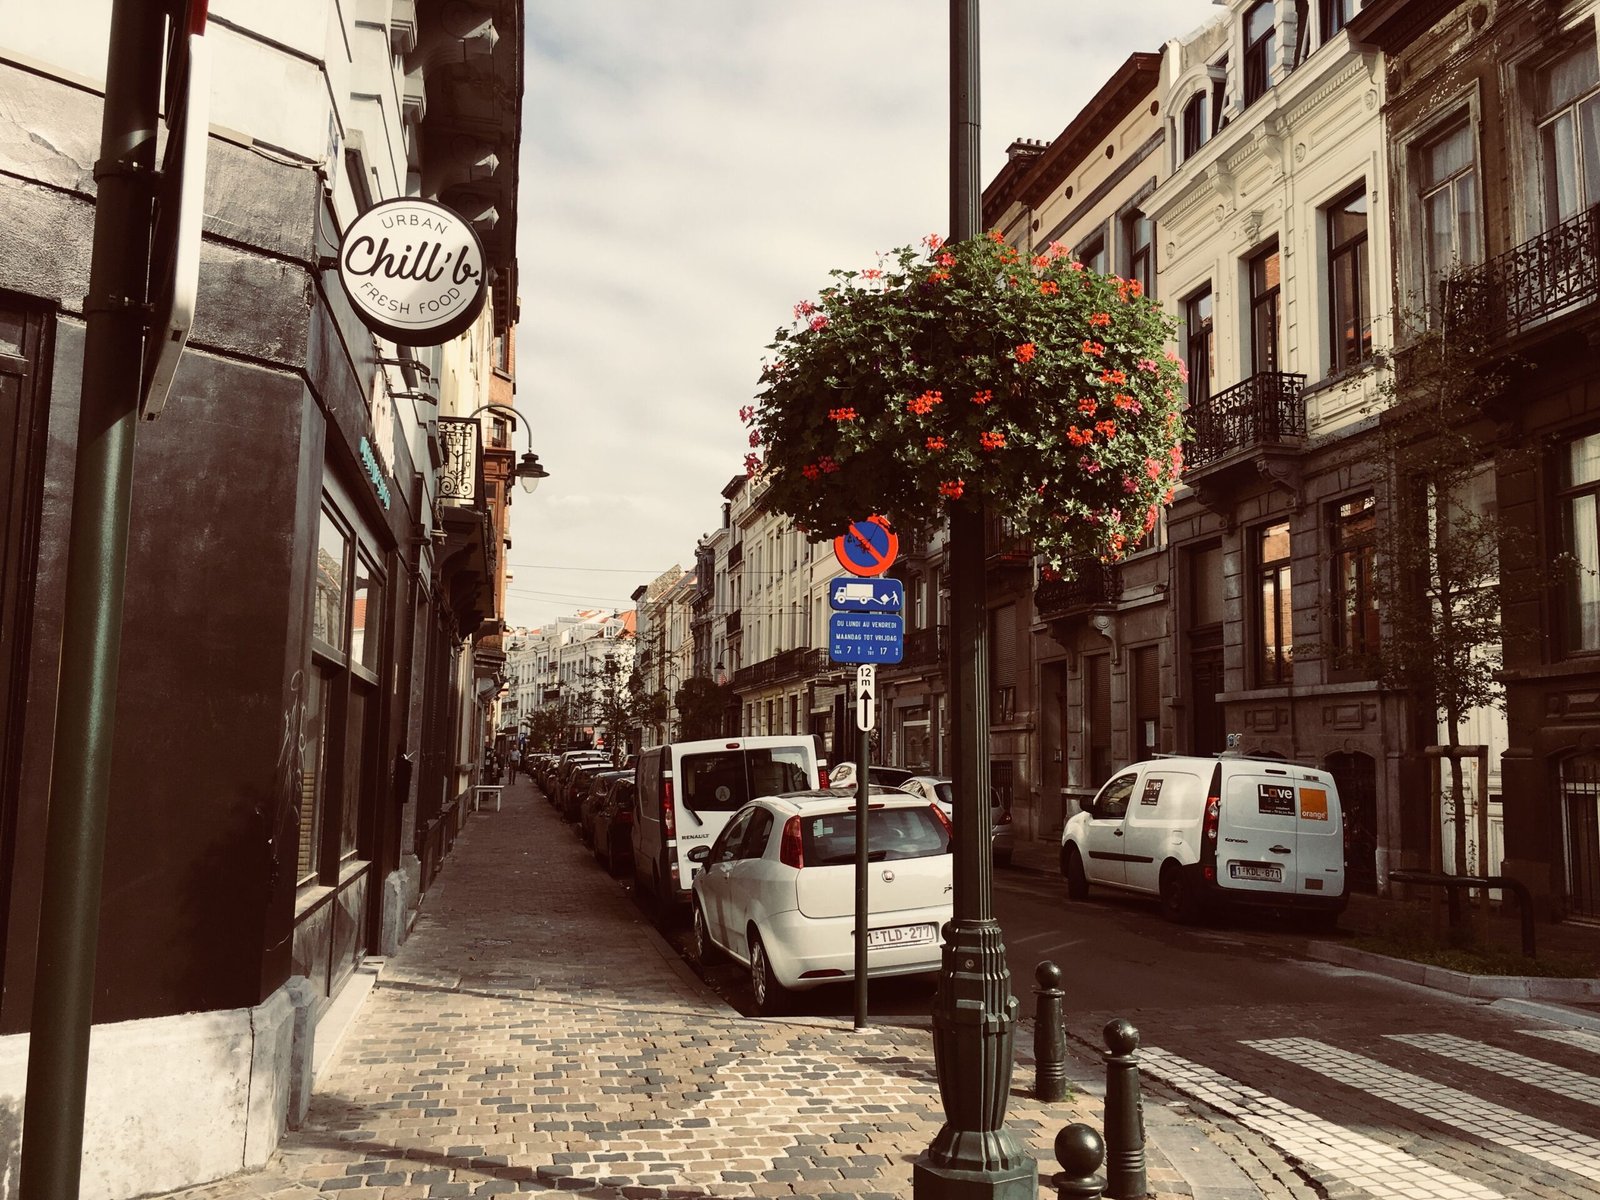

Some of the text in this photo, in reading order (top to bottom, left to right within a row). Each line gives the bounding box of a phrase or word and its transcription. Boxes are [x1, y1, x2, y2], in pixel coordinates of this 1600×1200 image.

[382, 214, 448, 235] URBAN
[360, 281, 461, 315] FRESH FOOD
[846, 645, 852, 654] 7
[880, 647, 887, 655] 17
[860, 668, 871, 677] 12
[861, 679, 871, 687] m
[1259, 785, 1293, 799] Love
[1302, 811, 1326, 820] orange
